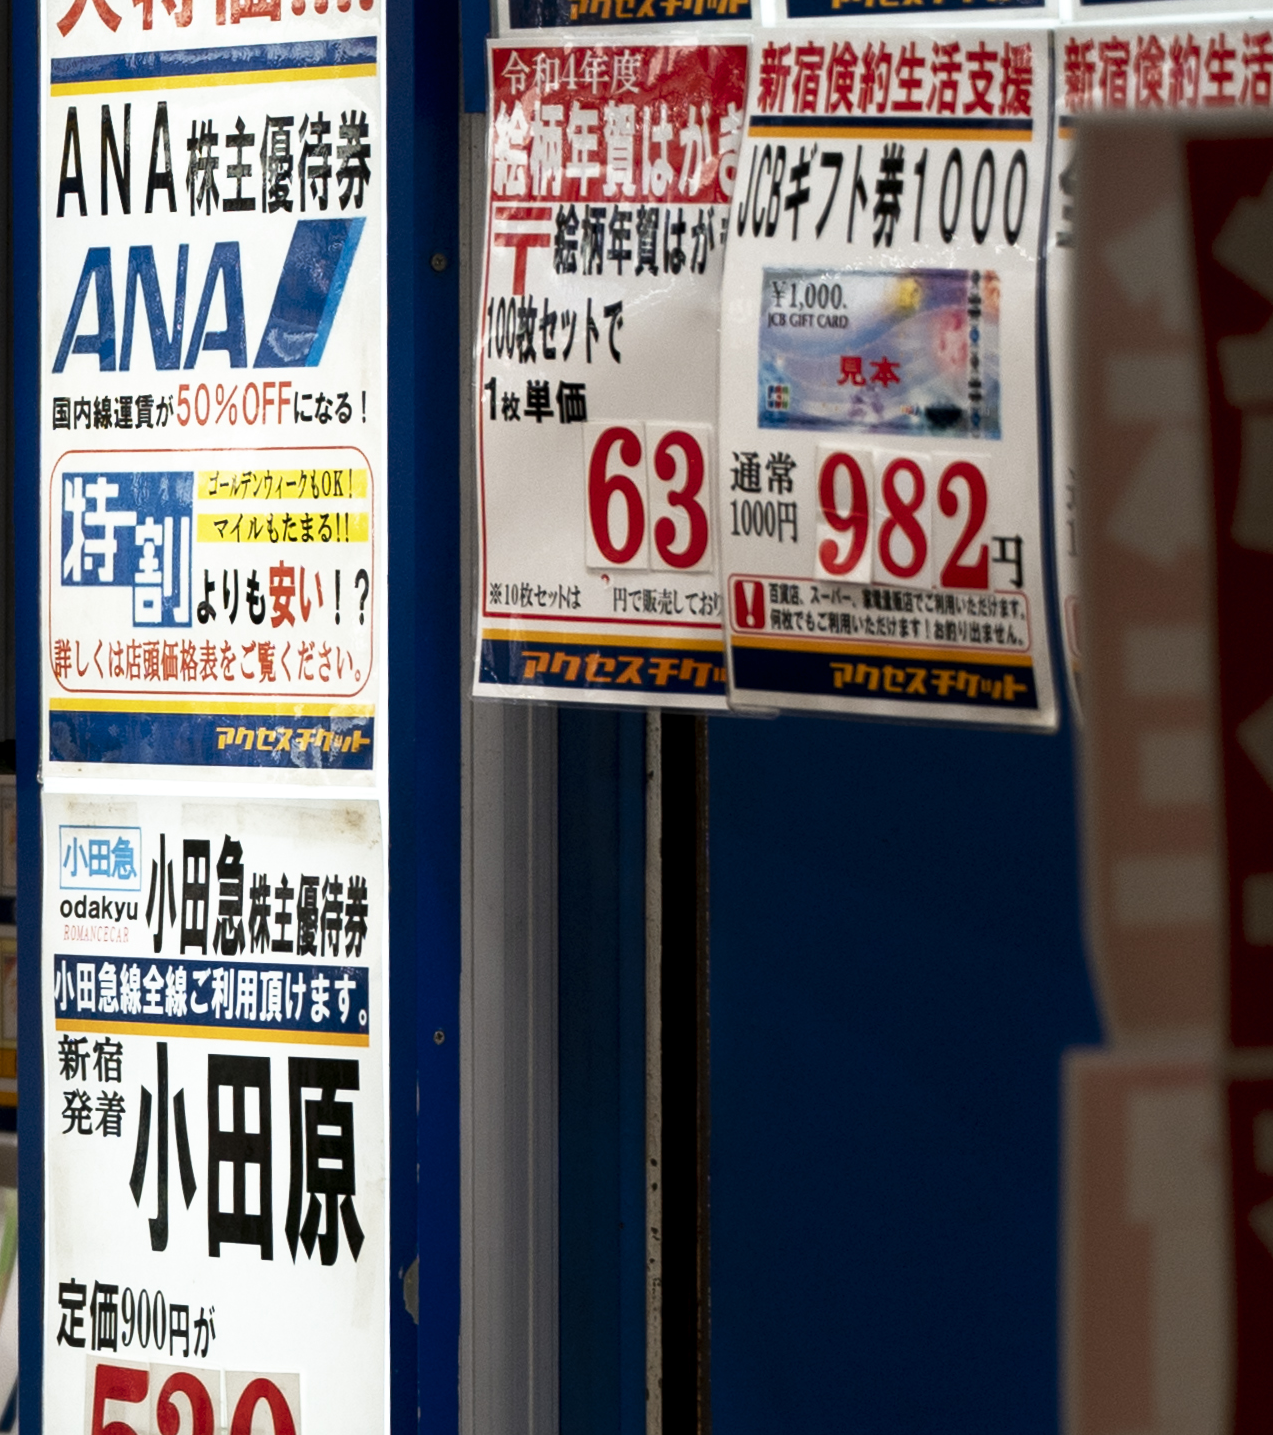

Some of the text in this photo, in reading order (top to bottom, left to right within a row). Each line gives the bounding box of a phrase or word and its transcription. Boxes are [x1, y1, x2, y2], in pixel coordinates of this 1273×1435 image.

[500, 49, 642, 95] 令和4年度
[757, 40, 1033, 118] 新宿倹約生活支援
[55, 101, 372, 218] ANA株主優待券
[52, 240, 249, 375] ANA
[485, 294, 624, 364] 100枚セットで
[768, 313, 849, 330] JCB GIFT CARD
[836, 355, 901, 389] 見本
[485, 379, 588, 425] 1枚単価
[587, 426, 710, 569] 63
[730, 451, 798, 496] 通常
[730, 500, 798, 543] 1000円
[62, 475, 191, 627] 特割
[53, 637, 363, 683] 詳しくは店頭価格表をご覧ください。
[829, 661, 1028, 702] アクセスチケット
[215, 725, 371, 756] アクセスチケット
[61, 833, 139, 883] 小田急
[59, 895, 140, 924] odakyu
[145, 831, 370, 960] 小田急株主優待券
[63, 923, 131, 944] ROMANCECAR
[54, 961, 370, 1029] 小田急線全線ご利用頂けます。
[57, 1034, 123, 1084] 新宿
[60, 1087, 127, 1138] 発着
[127, 1040, 365, 1267] 小田原
[55, 1277, 217, 1360] 定価900円が
